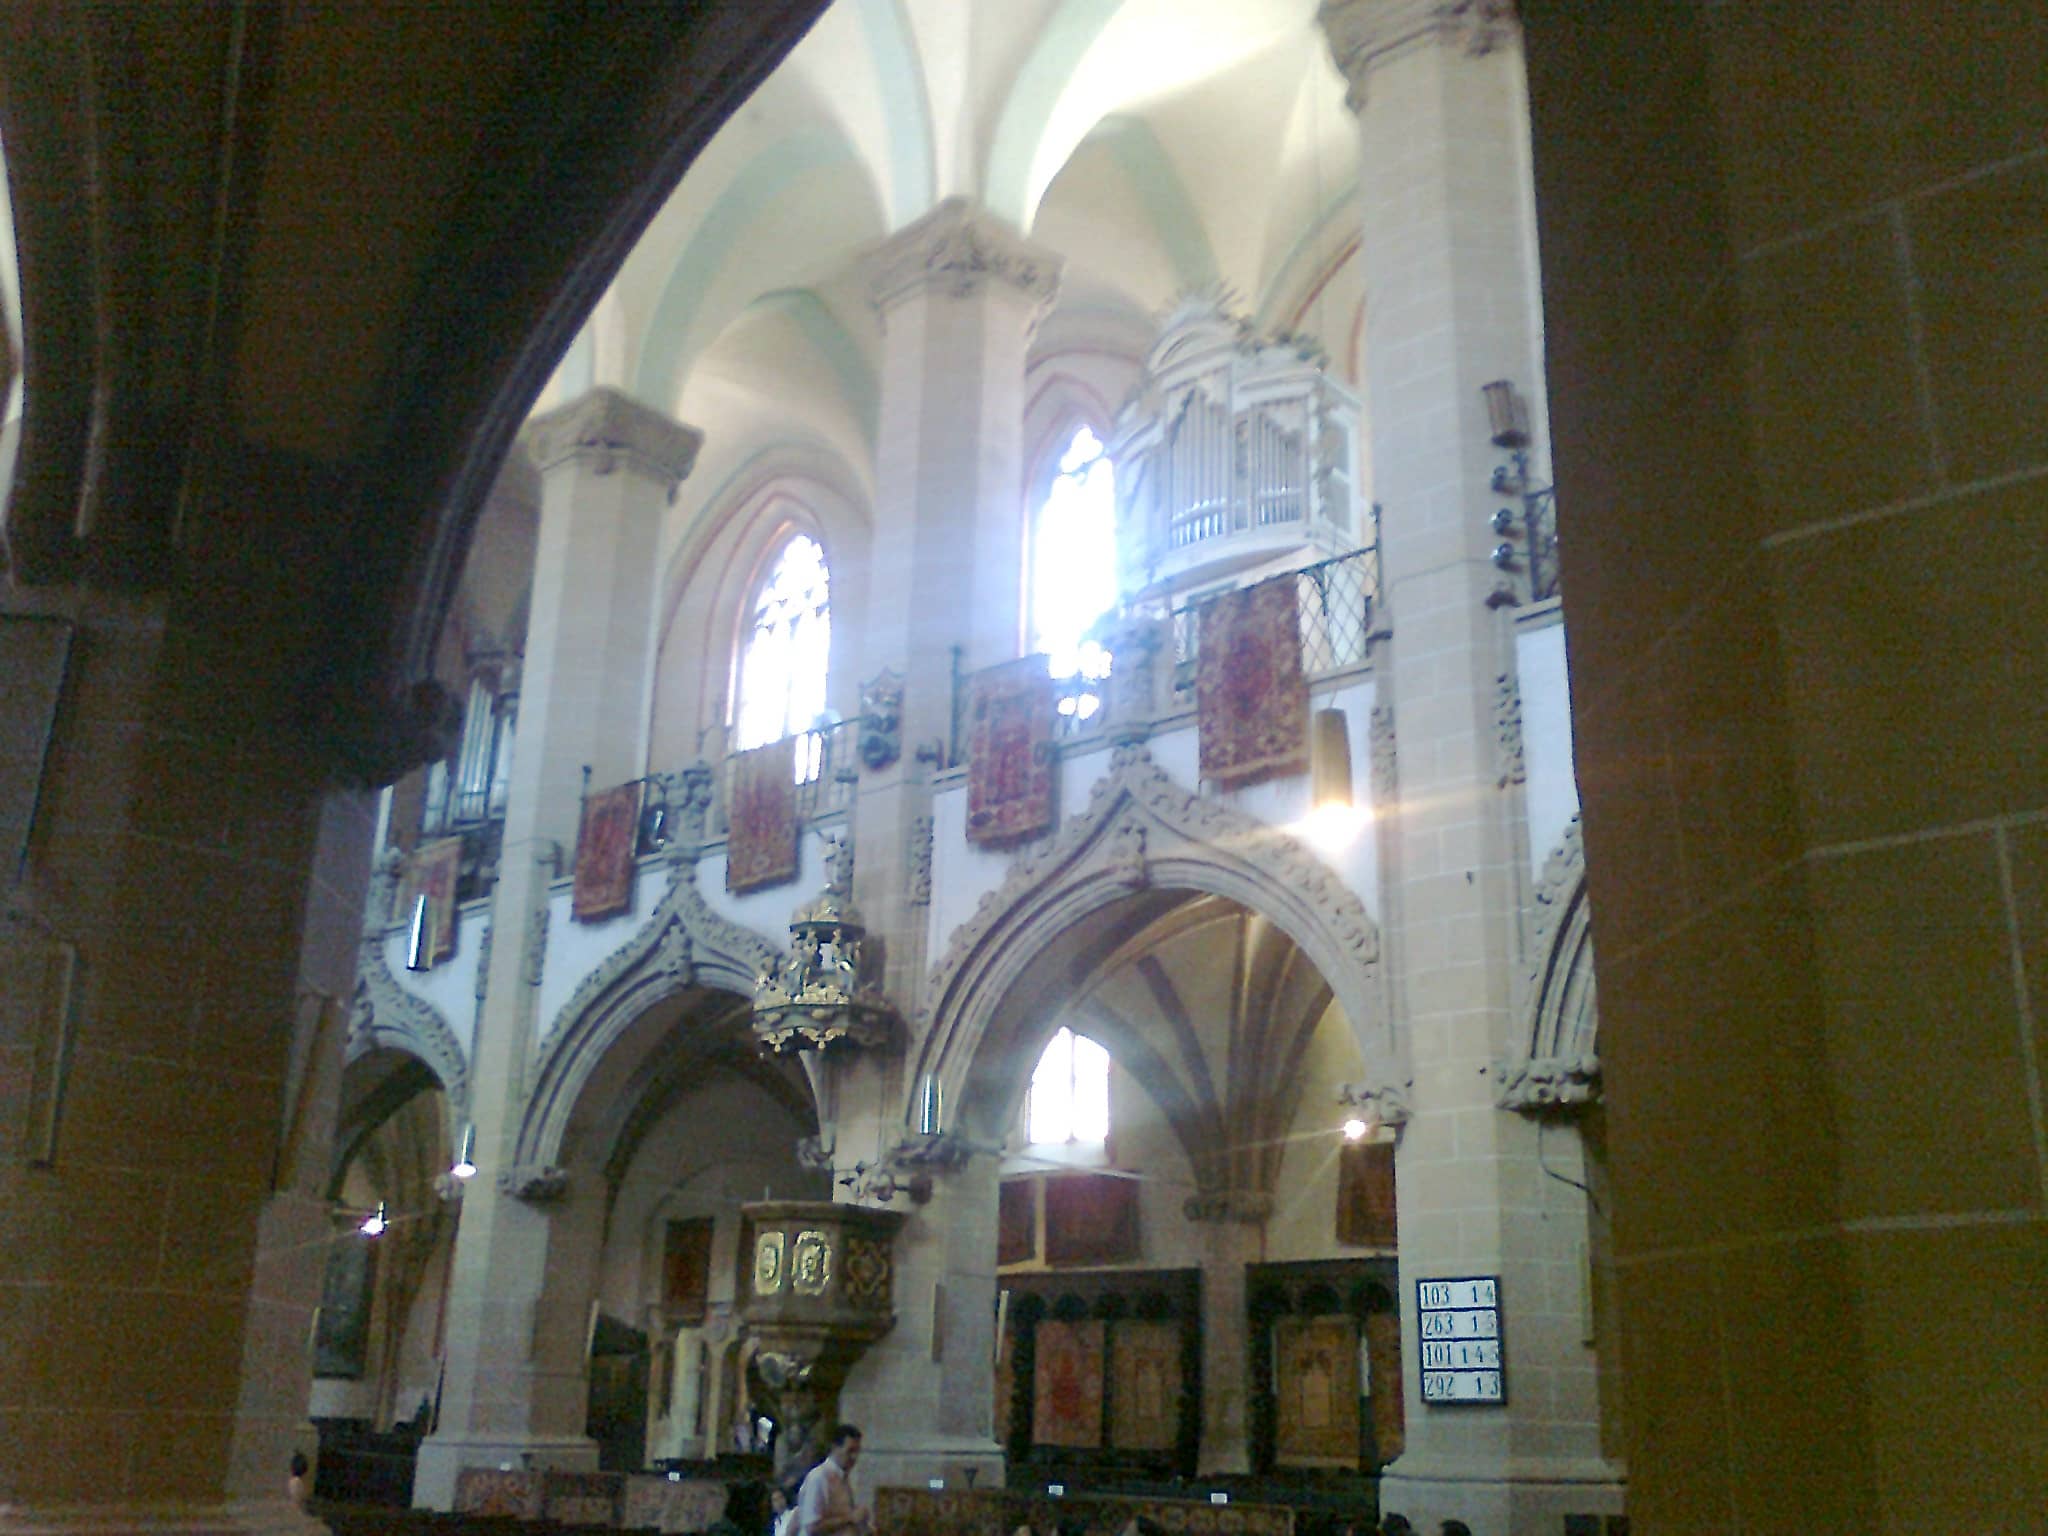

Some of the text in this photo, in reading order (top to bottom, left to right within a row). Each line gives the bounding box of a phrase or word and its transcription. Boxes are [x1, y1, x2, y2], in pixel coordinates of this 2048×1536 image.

[1423, 1285, 1450, 1305] 103
[1425, 1314, 1453, 1336] 263
[1426, 1344, 1452, 1366] 101
[1425, 1375, 1455, 1397] 292
